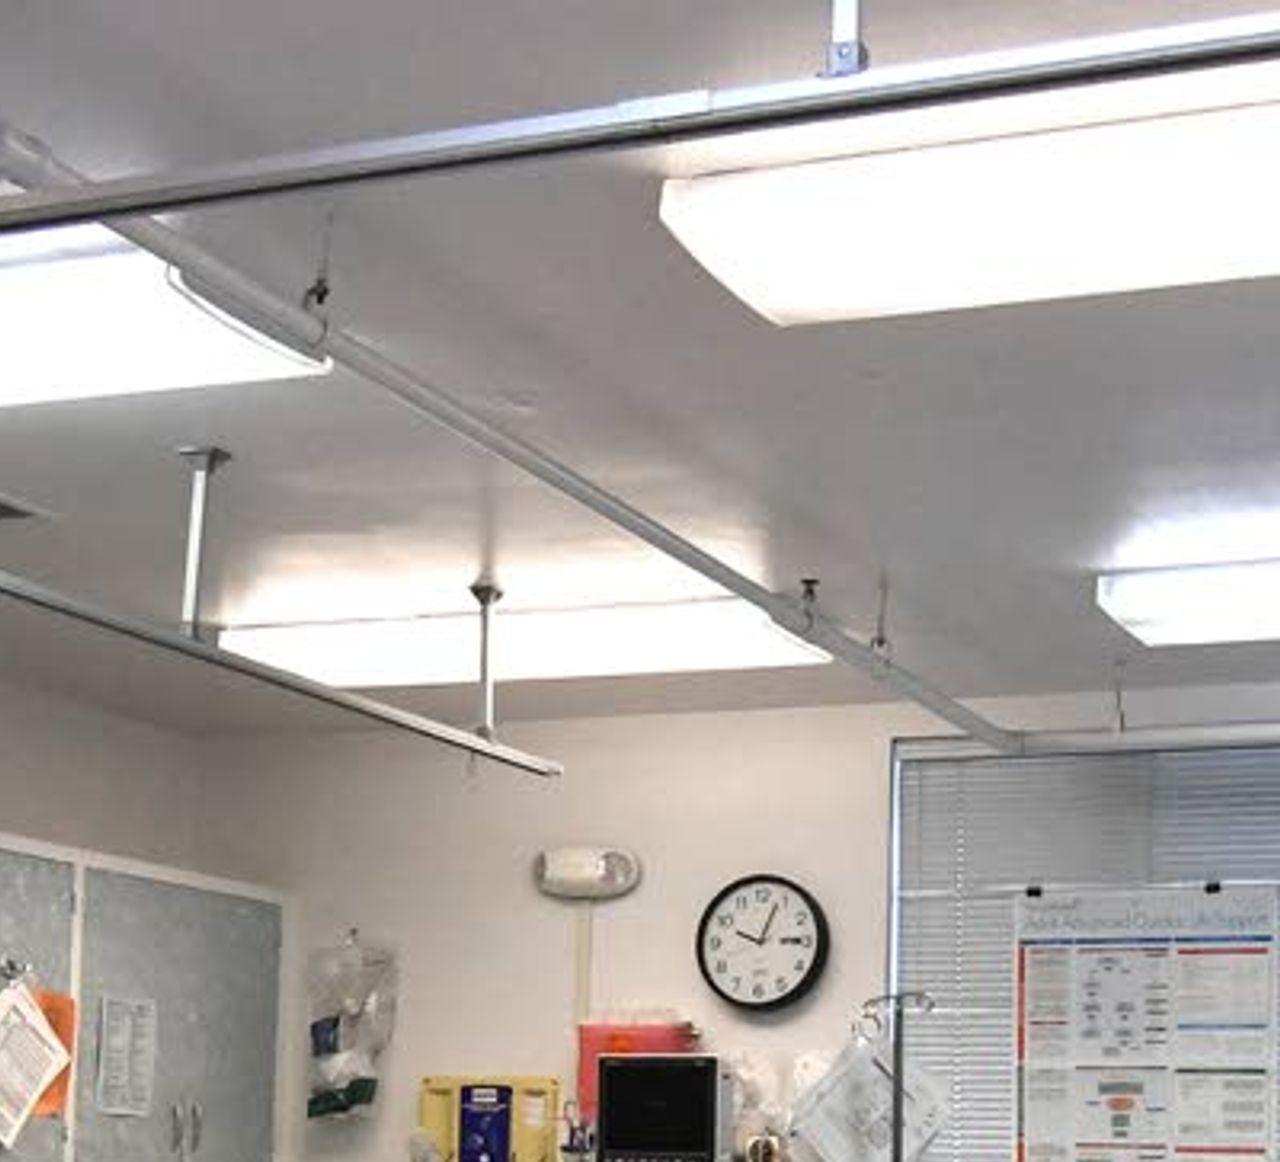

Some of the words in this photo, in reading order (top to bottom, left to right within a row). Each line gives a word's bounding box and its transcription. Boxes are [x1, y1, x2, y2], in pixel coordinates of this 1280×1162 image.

[735, 895, 748, 910] 11
[755, 886, 772, 904] 12
[716, 912, 735, 929] 10
[794, 910, 809, 927] 2
[710, 935, 723, 952] 9
[715, 959, 729, 974] 8
[793, 959, 805, 973] 4
[729, 976, 742, 993] 7
[751, 983, 765, 999] 6
[774, 976, 789, 993] 5
